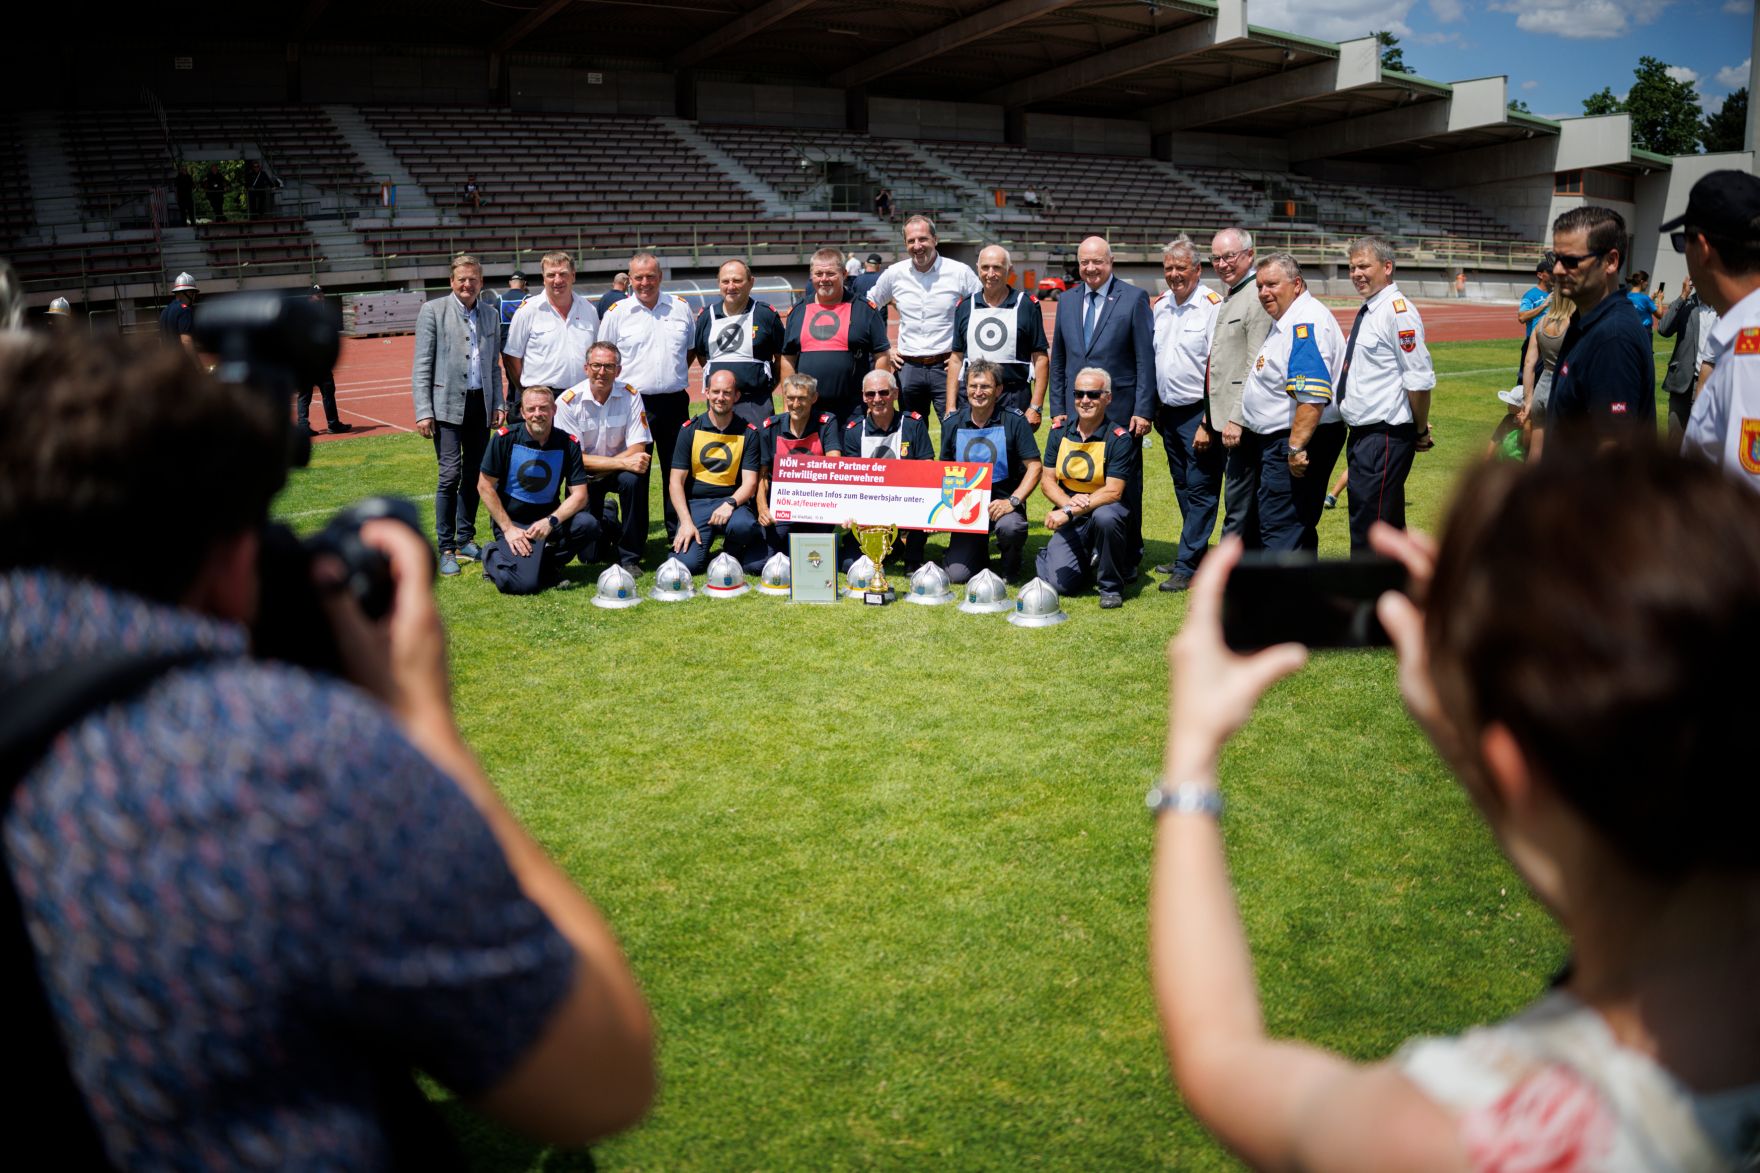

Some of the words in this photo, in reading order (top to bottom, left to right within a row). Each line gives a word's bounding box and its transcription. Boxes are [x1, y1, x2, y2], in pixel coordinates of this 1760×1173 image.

[780, 457, 798, 468] NÖN
[806, 460, 837, 470] starker
[838, 461, 871, 471] Partner
[871, 463, 887, 472] der
[778, 469, 828, 481] Freiwilligen
[829, 472, 885, 483] Feuerwehren
[777, 488, 791, 496] Alle
[791, 489, 824, 498] aktuellen
[825, 490, 842, 499] Infos
[859, 493, 902, 503] Bewerbsjahr
[776, 498, 838, 508] NÖN.at/feuerwehr
[776, 511, 790, 519] NÖN
